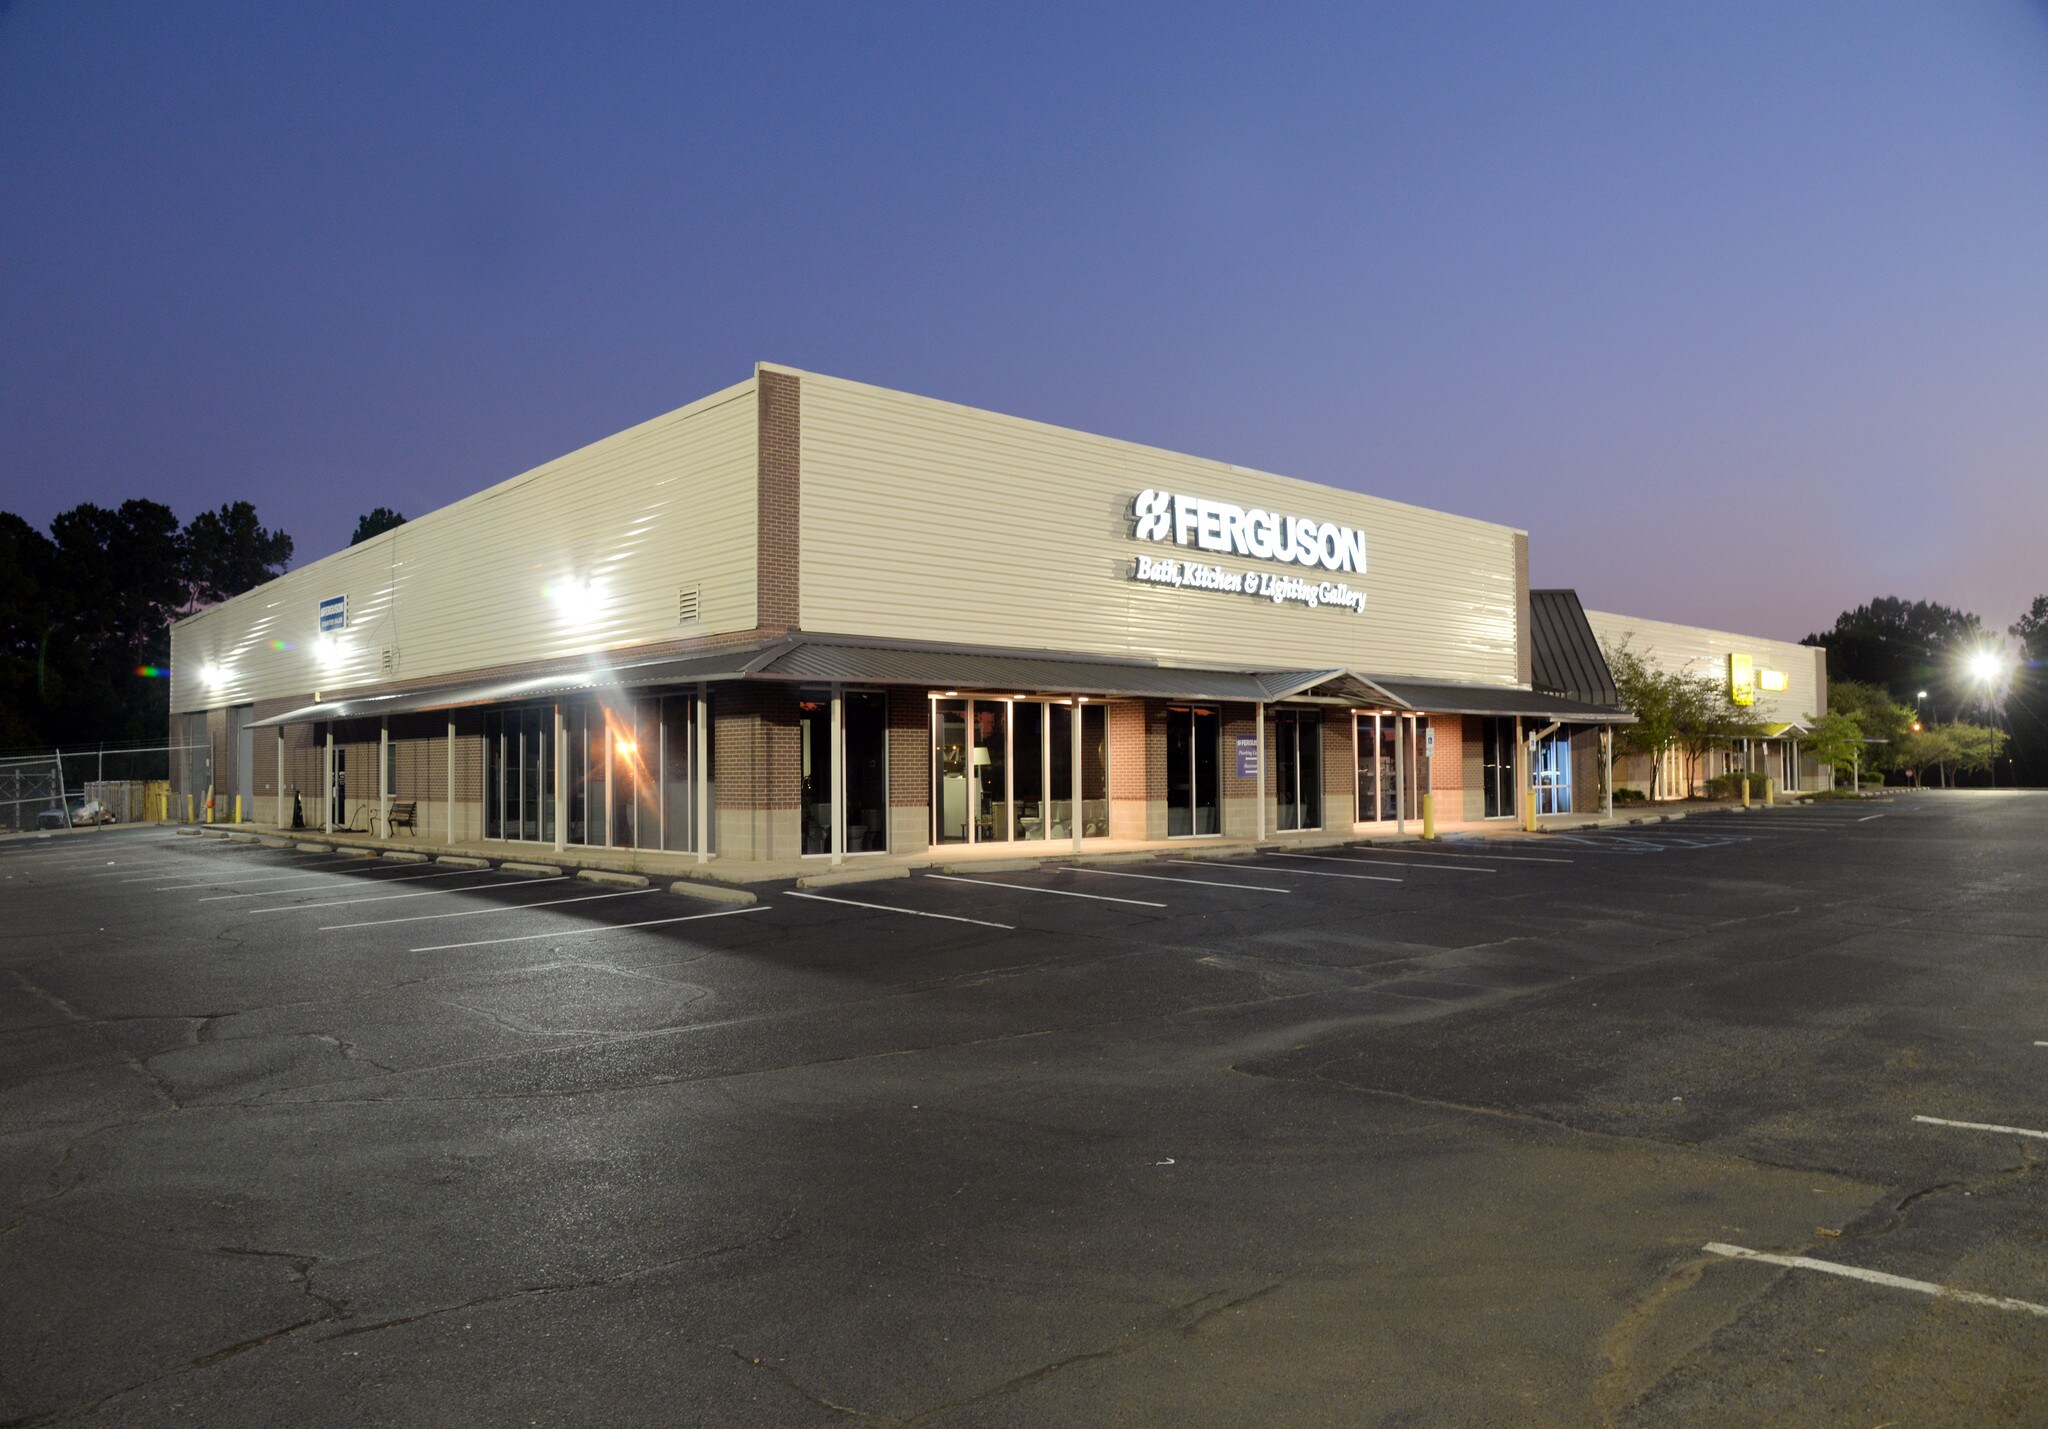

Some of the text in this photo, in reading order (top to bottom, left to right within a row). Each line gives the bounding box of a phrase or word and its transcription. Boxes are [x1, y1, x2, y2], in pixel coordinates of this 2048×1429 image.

[1173, 494, 1367, 574] FERGUSON
[323, 602, 343, 616] FERGUSON
[1137, 556, 1367, 613] Bath, Kitchen & Lighting Gallery
